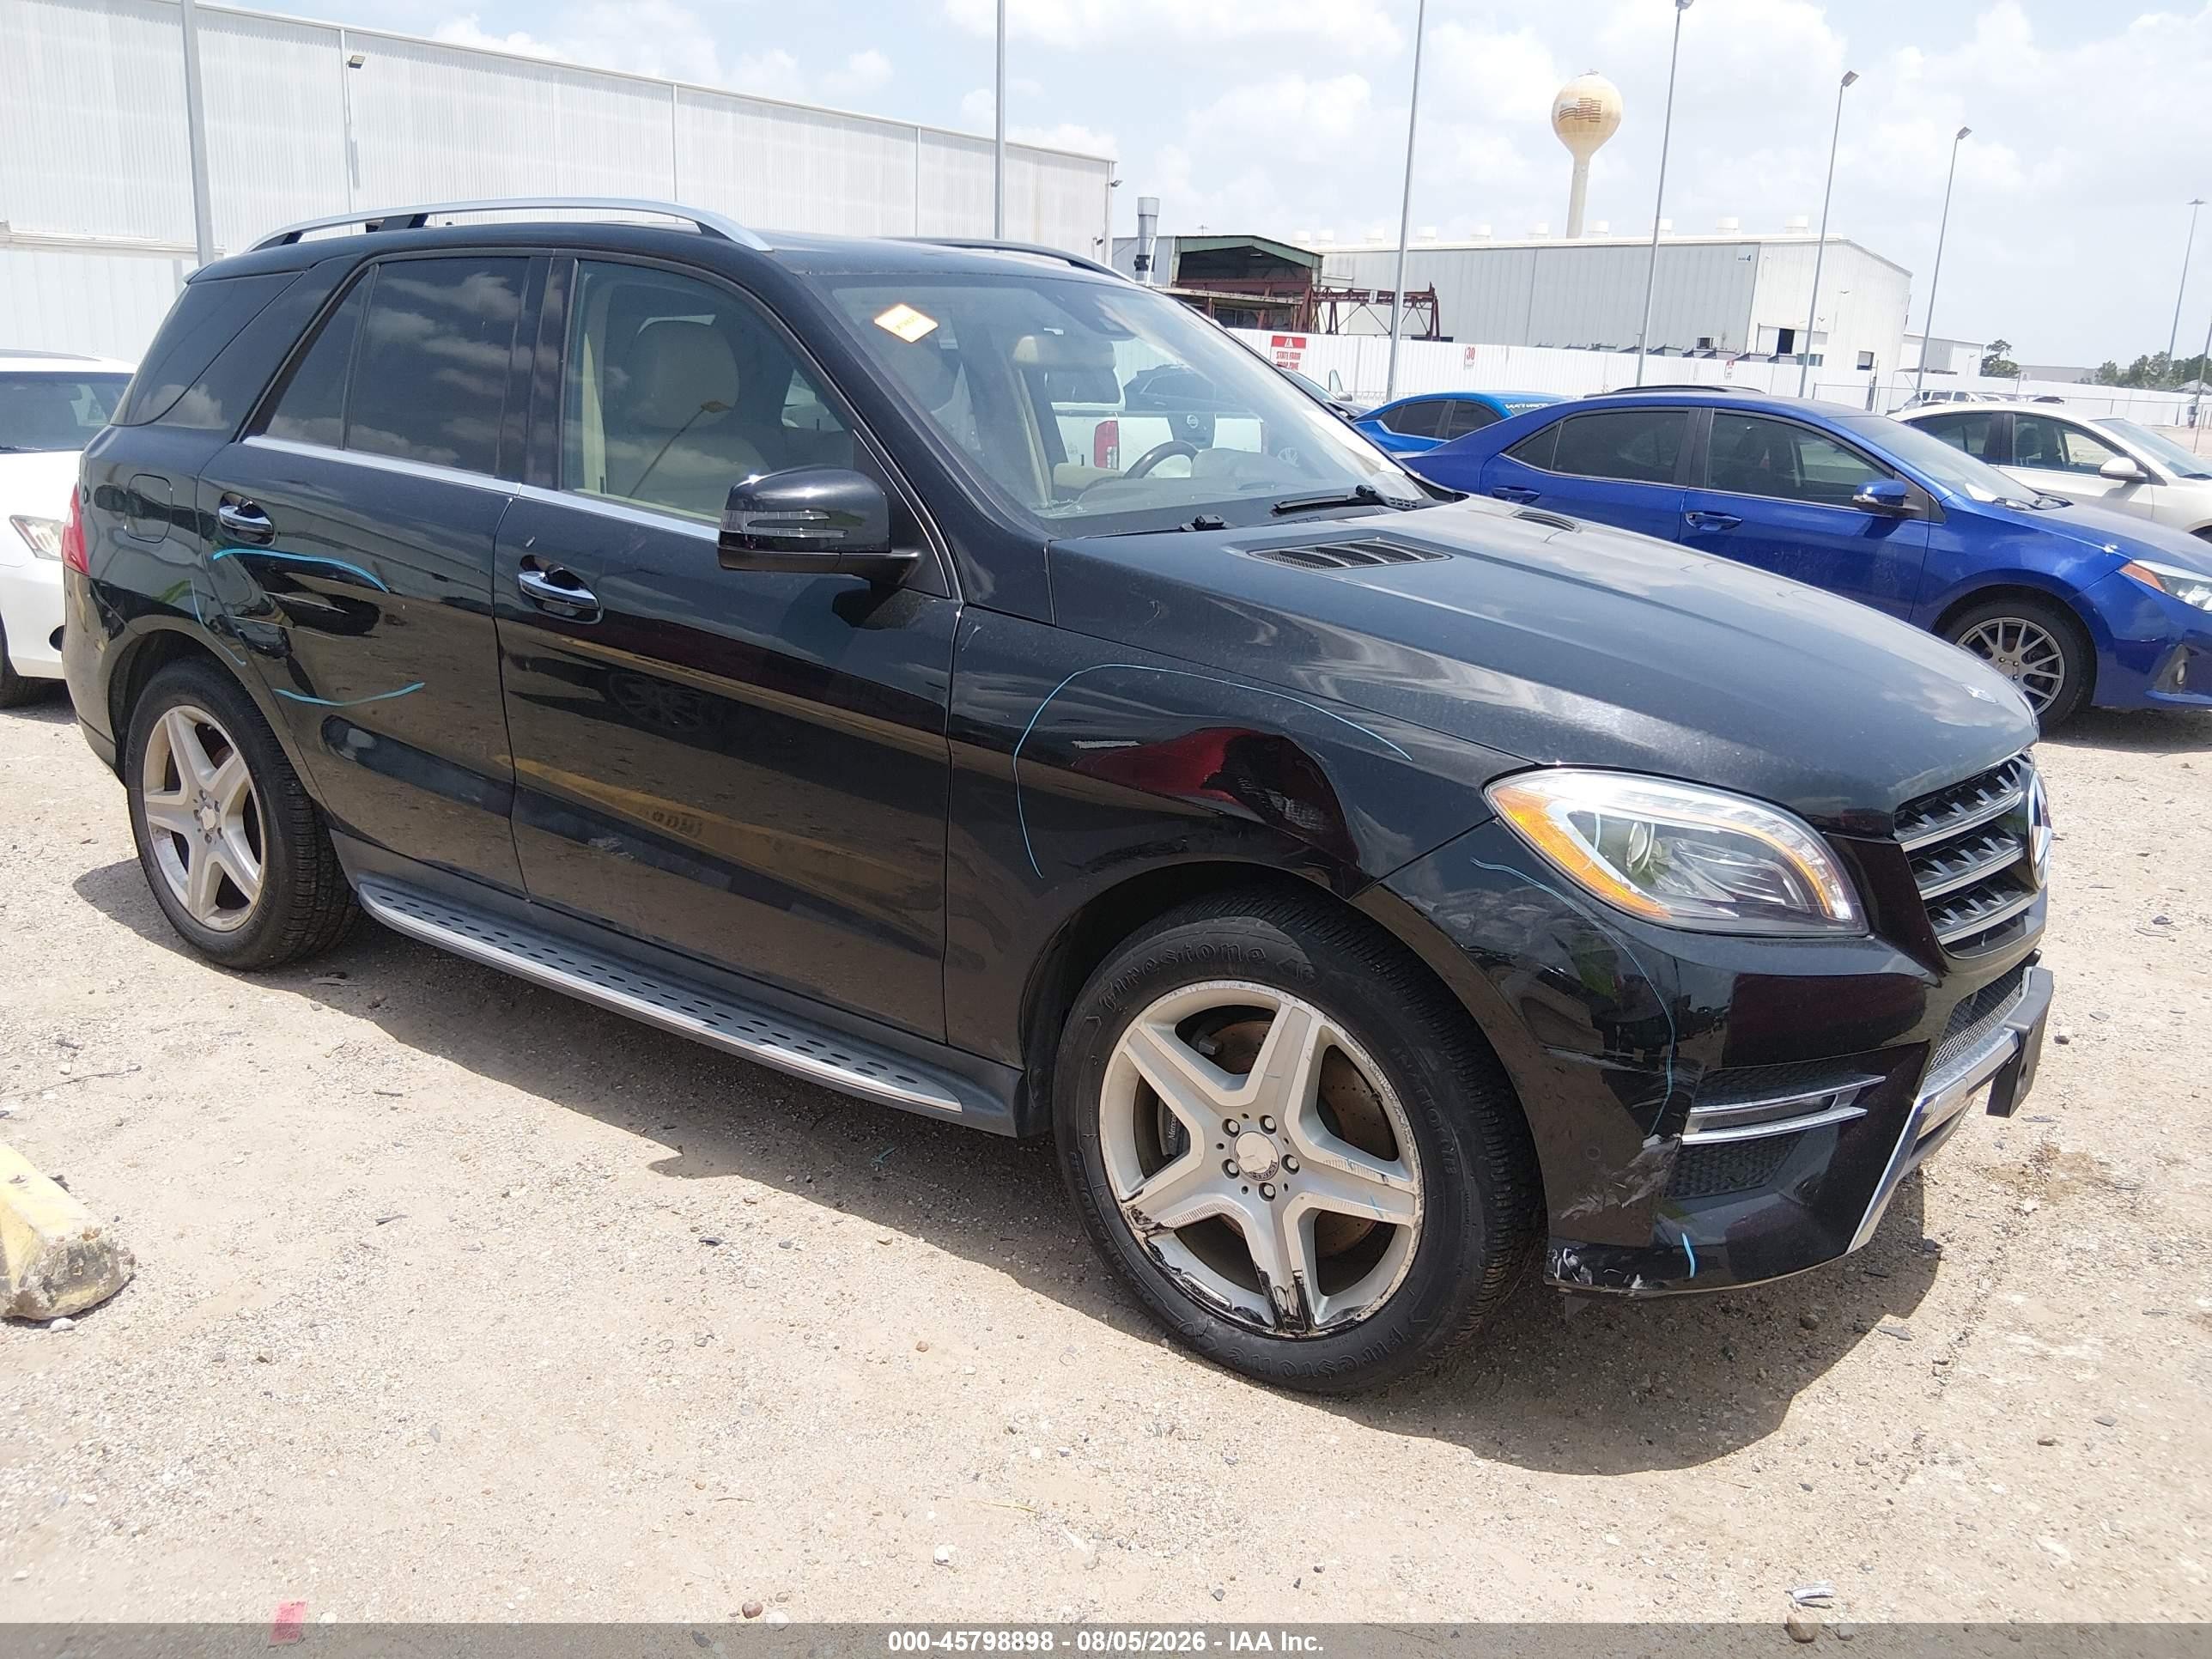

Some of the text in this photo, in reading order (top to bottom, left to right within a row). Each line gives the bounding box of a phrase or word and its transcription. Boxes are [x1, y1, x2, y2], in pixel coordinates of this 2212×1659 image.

[1276, 351, 1289, 360] STATE
[1466, 346, 1476, 361] 30
[1097, 942, 1267, 1011] Firestone
